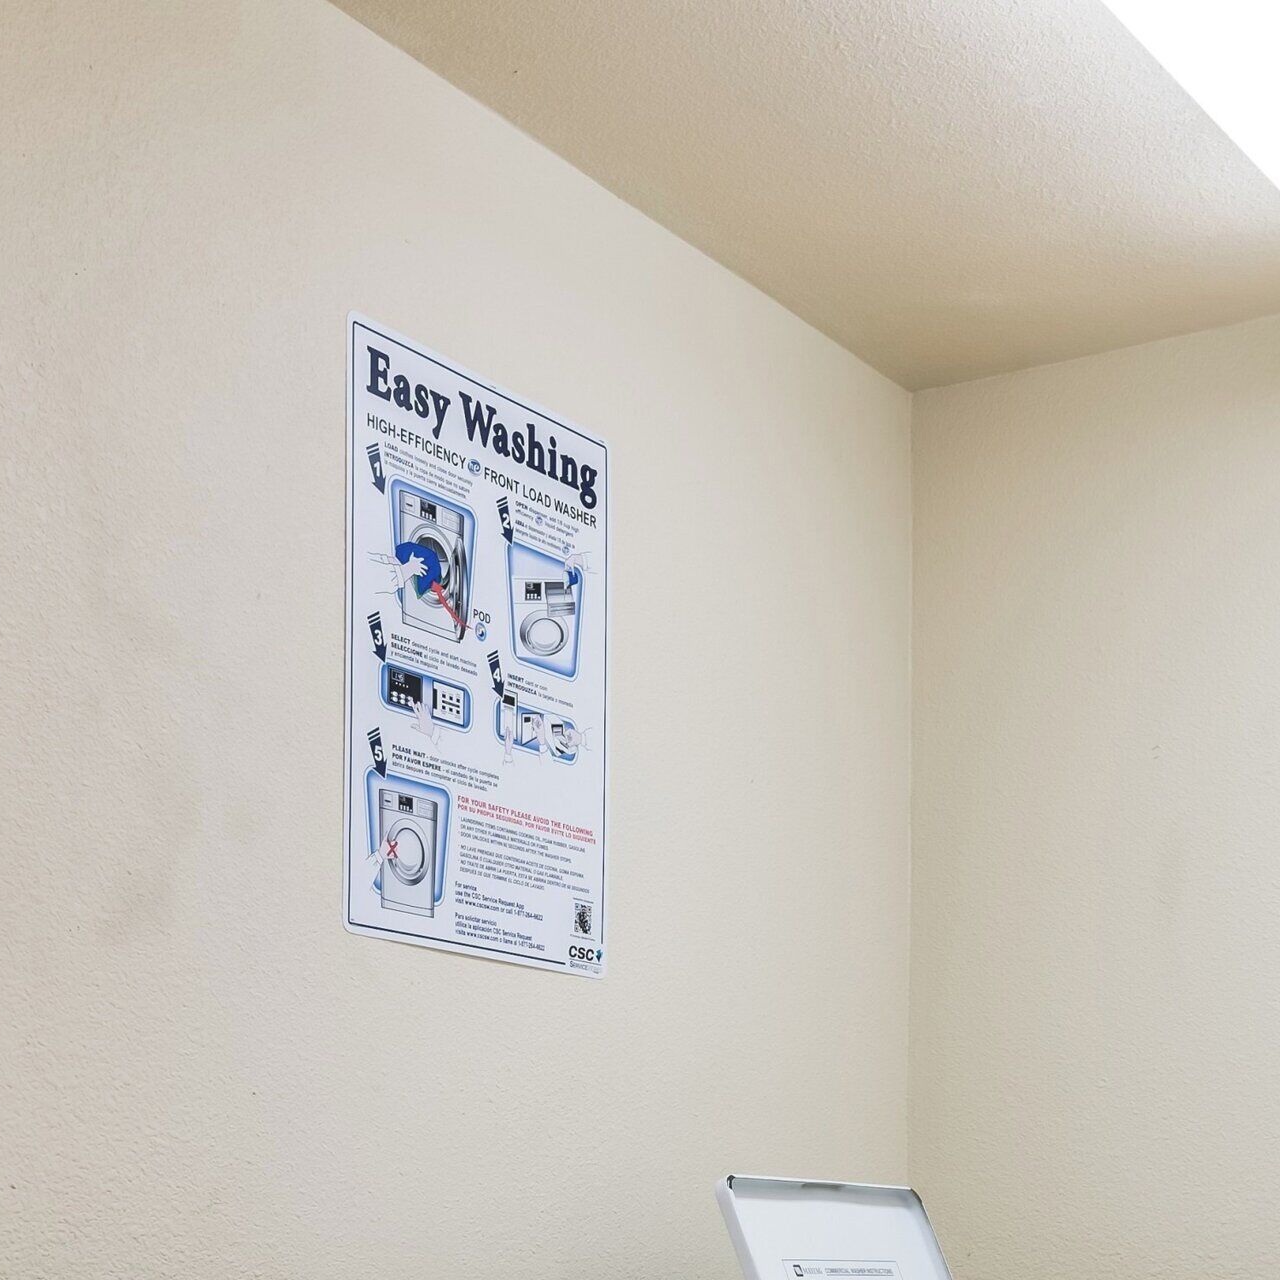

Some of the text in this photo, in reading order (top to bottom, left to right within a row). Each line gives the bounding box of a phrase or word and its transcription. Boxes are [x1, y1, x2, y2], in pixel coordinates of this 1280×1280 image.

[366, 345, 451, 439] Easy
[459, 390, 598, 510] Washing
[367, 413, 467, 468] HIGH-EFFICIENCY
[484, 466, 519, 493] FRONT
[522, 484, 551, 508] LOAD
[554, 499, 596, 528] WASHER
[473, 608, 491, 624] POD
[374, 629, 382, 646] 3
[391, 633, 410, 644] SELECT
[492, 667, 501, 682] 4
[508, 673, 524, 682] INSERT
[374, 748, 383, 762] 5
[392, 744, 425, 758] PLEASE WAIT
[569, 946, 594, 961] CSC
